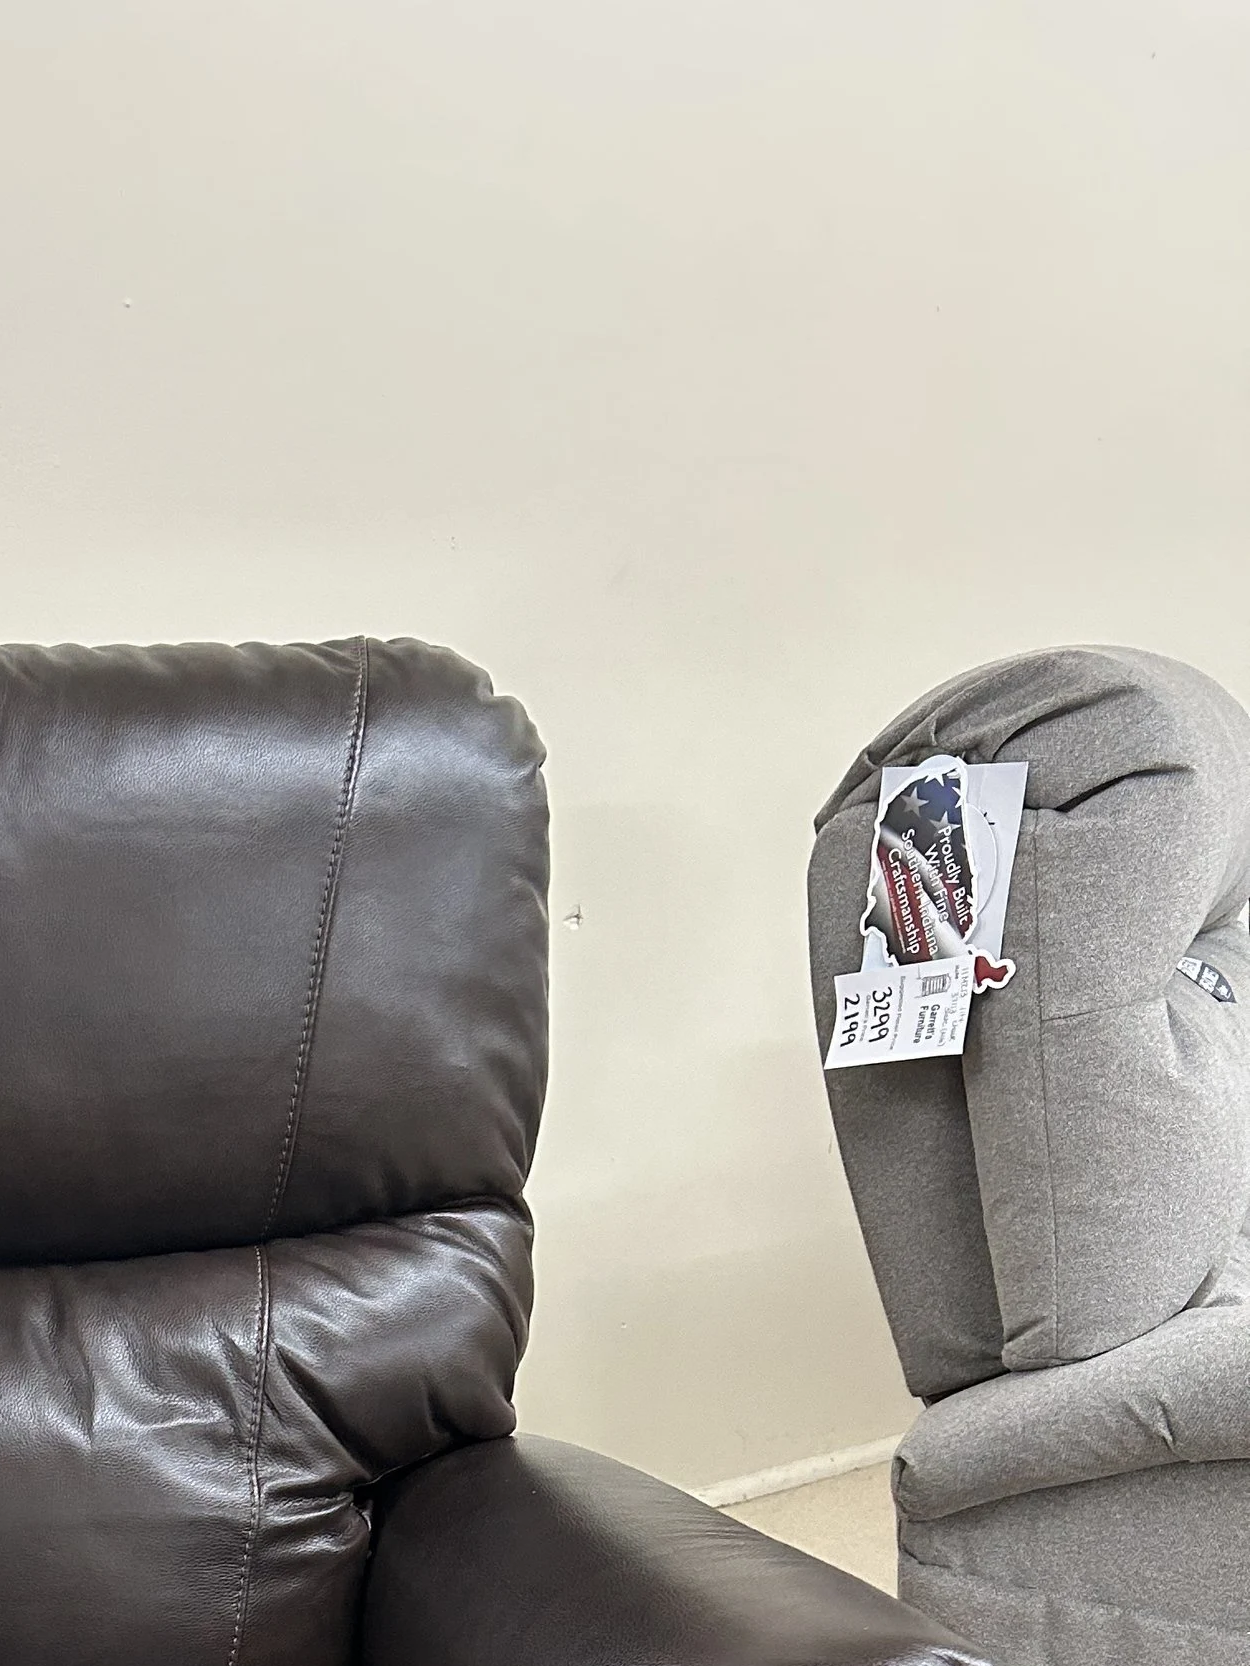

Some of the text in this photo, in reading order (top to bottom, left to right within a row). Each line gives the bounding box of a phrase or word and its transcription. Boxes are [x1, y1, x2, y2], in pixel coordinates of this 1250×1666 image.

[888, 848, 922, 954] Craftsmanship
[901, 828, 939, 956] Southern Indiana
[925, 843, 949, 923] With Fine
[938, 825, 969, 925] Proudly Built
[840, 993, 861, 1048] 2199
[868, 986, 893, 1043] 3299
[913, 1005, 929, 1044] Furniture
[925, 1003, 941, 1040] Garrett's
